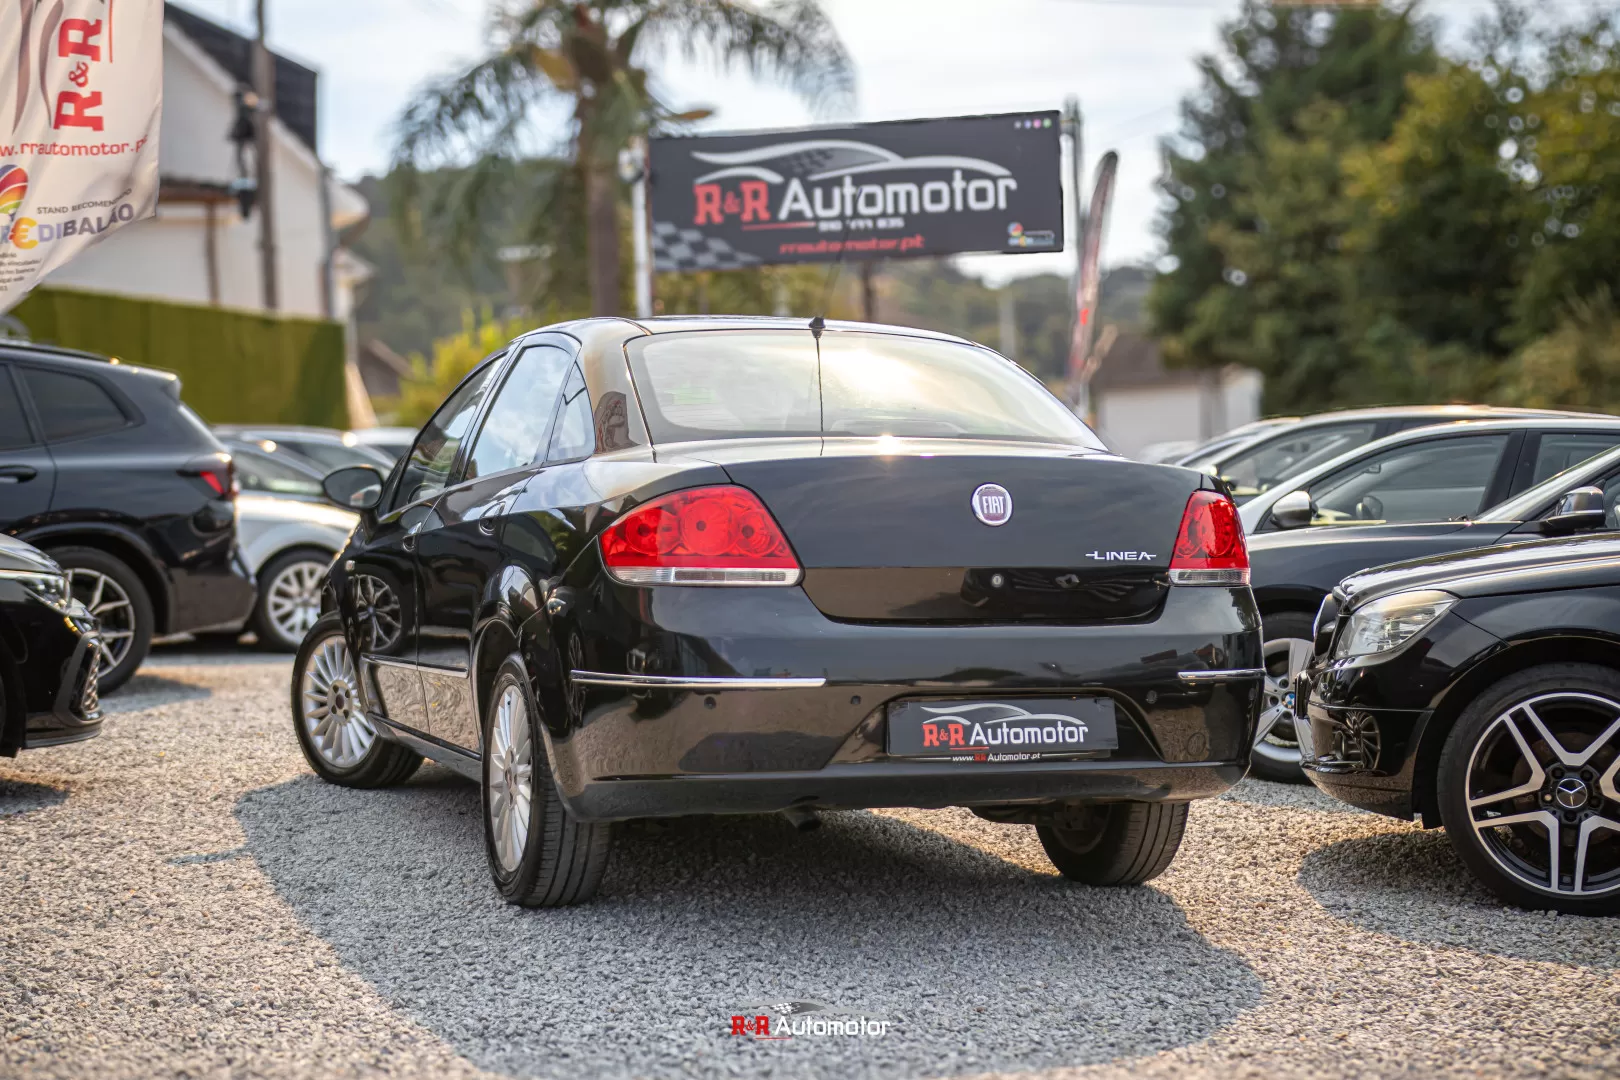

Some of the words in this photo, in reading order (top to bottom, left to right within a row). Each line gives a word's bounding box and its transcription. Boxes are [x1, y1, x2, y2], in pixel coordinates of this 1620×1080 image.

[52, 18, 104, 132] R&R
[693, 180, 771, 225] R&R
[778, 170, 1017, 221] Automotor
[37, 205, 69, 215] STAND
[981, 496, 1005, 514] FIAT
[1088, 550, 1154, 561] LINEA
[922, 723, 965, 747] R&R
[969, 720, 1089, 746] Automotor
